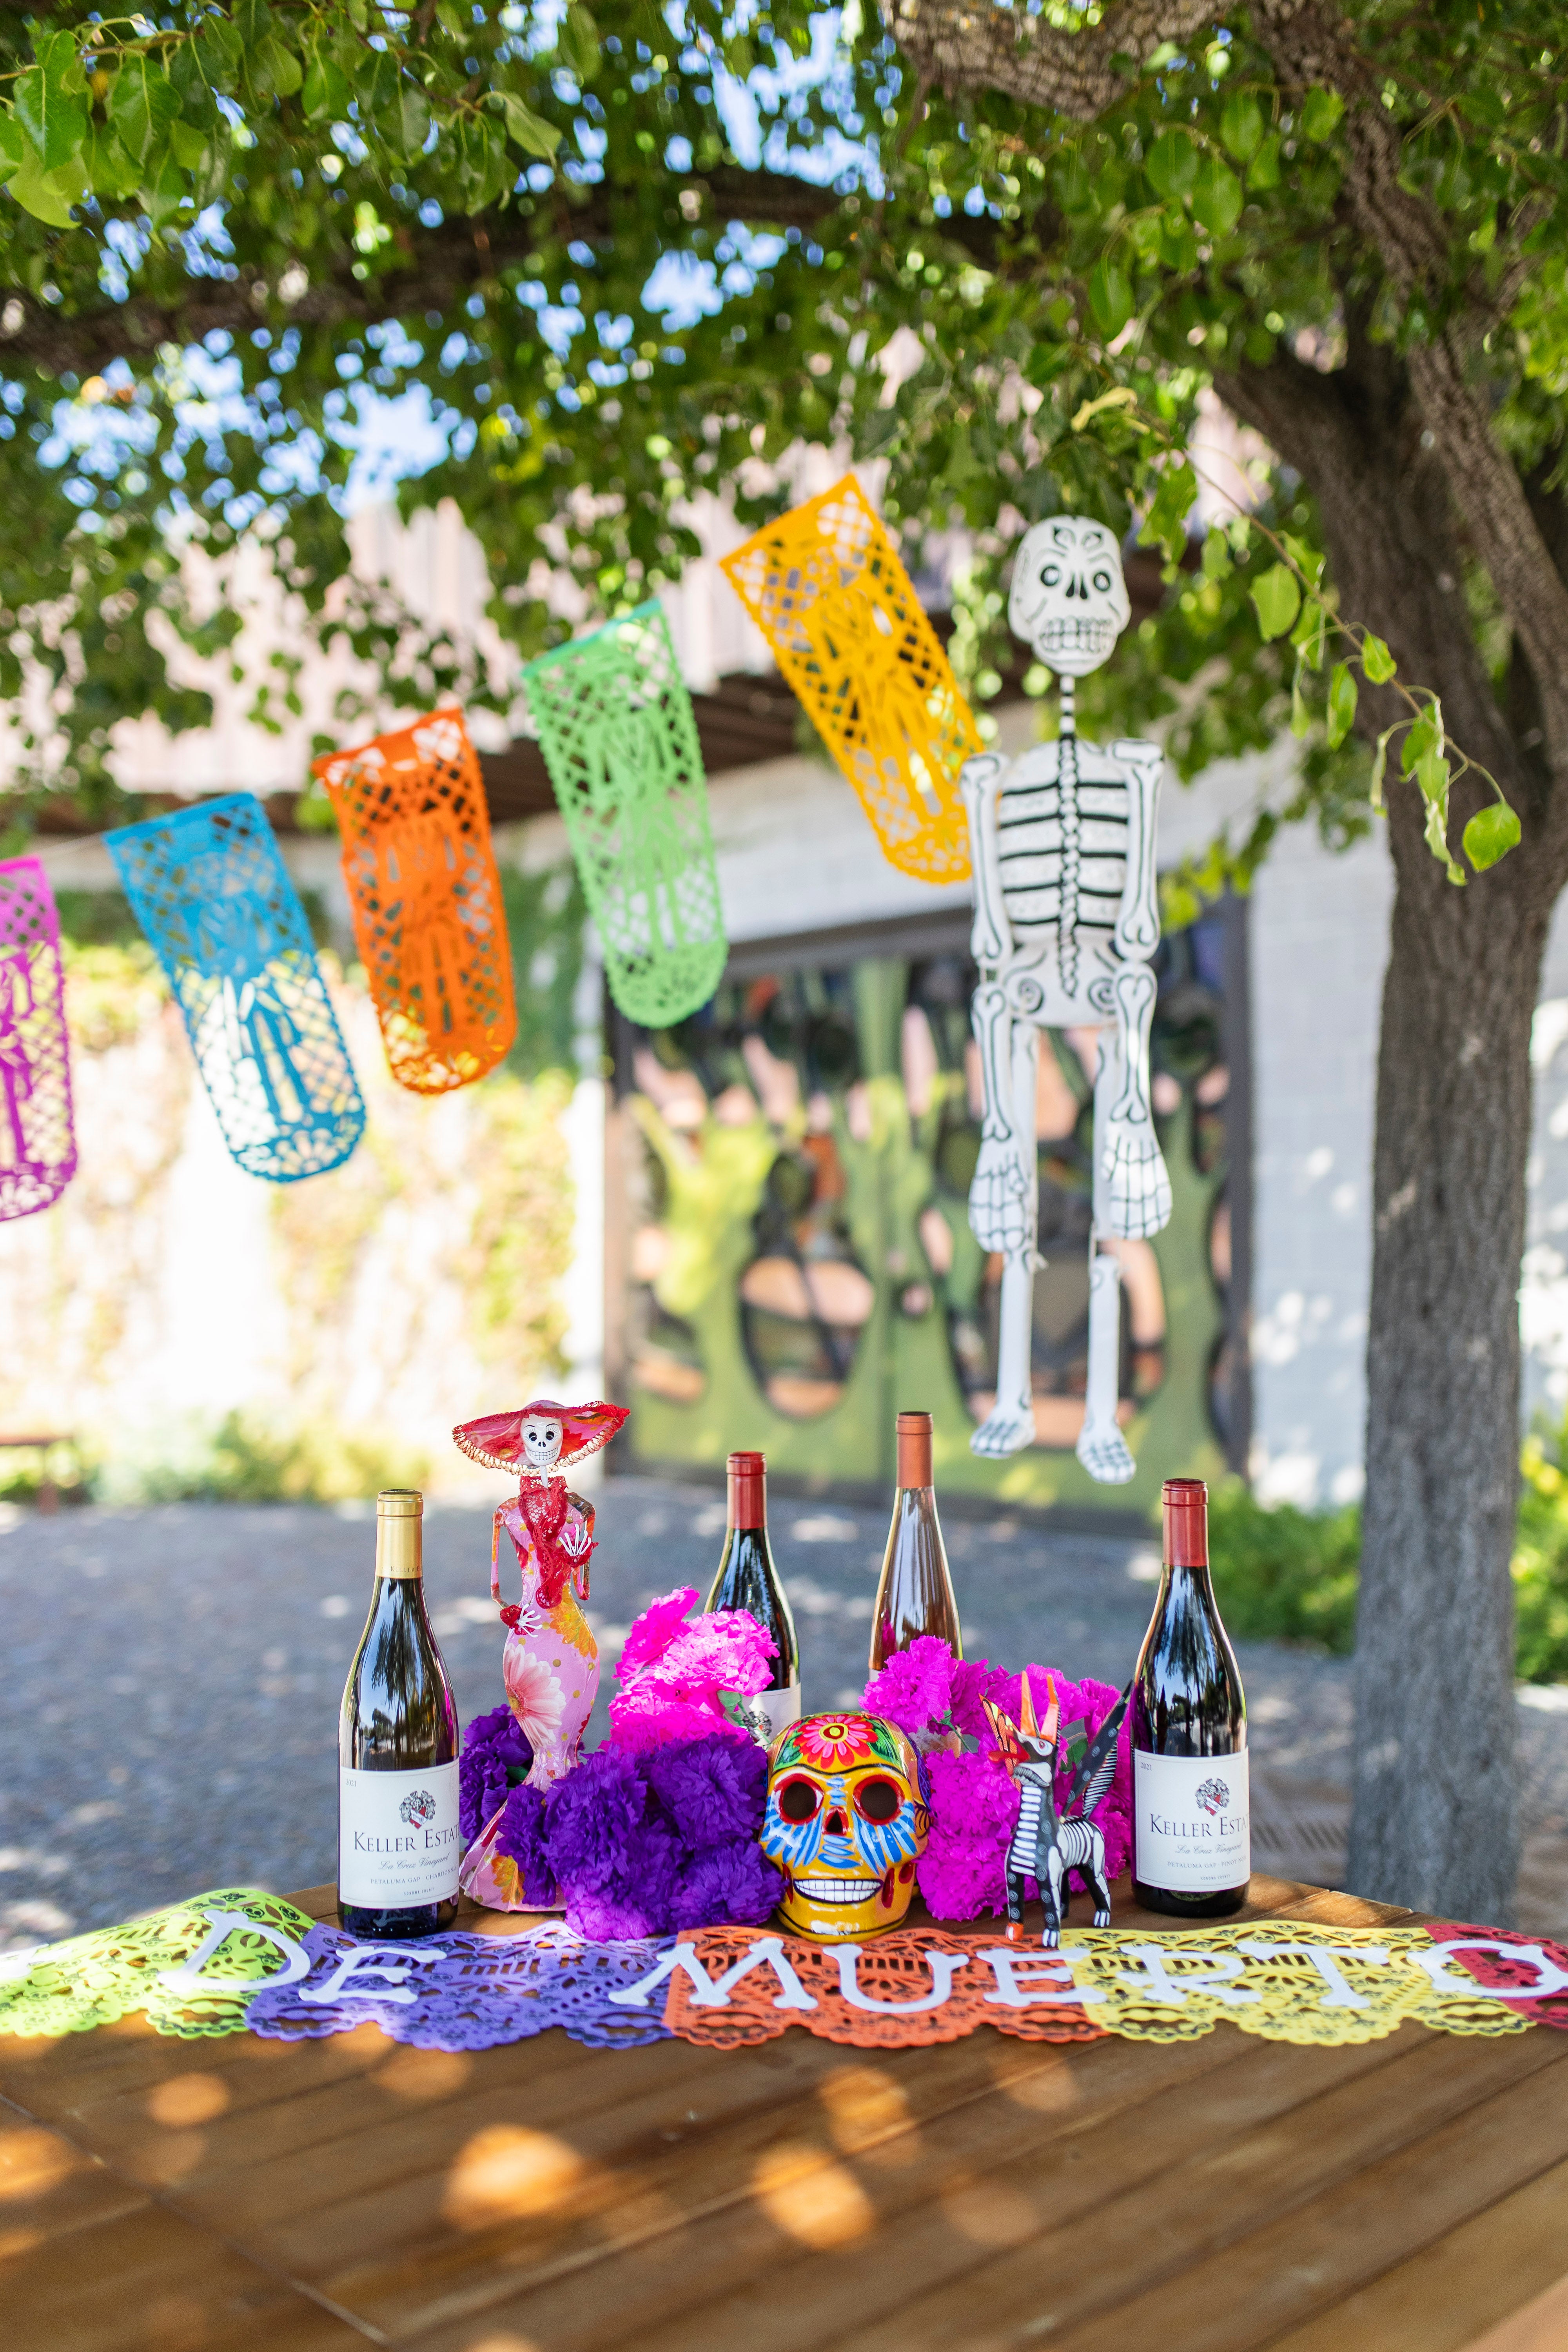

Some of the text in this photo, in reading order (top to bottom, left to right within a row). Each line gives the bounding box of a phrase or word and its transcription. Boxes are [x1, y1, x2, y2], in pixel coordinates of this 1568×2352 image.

[1141, 1762, 1152, 1771] 2021
[346, 1779, 356, 1787] 2021
[1150, 1813, 1214, 1837] KELLER
[354, 1831, 417, 1852] KELLER
[1175, 1840, 1243, 1855] La Cruz Vineyard
[378, 1852, 450, 1870] La Cruz Vineyard
[157, 1909, 447, 2004] DE
